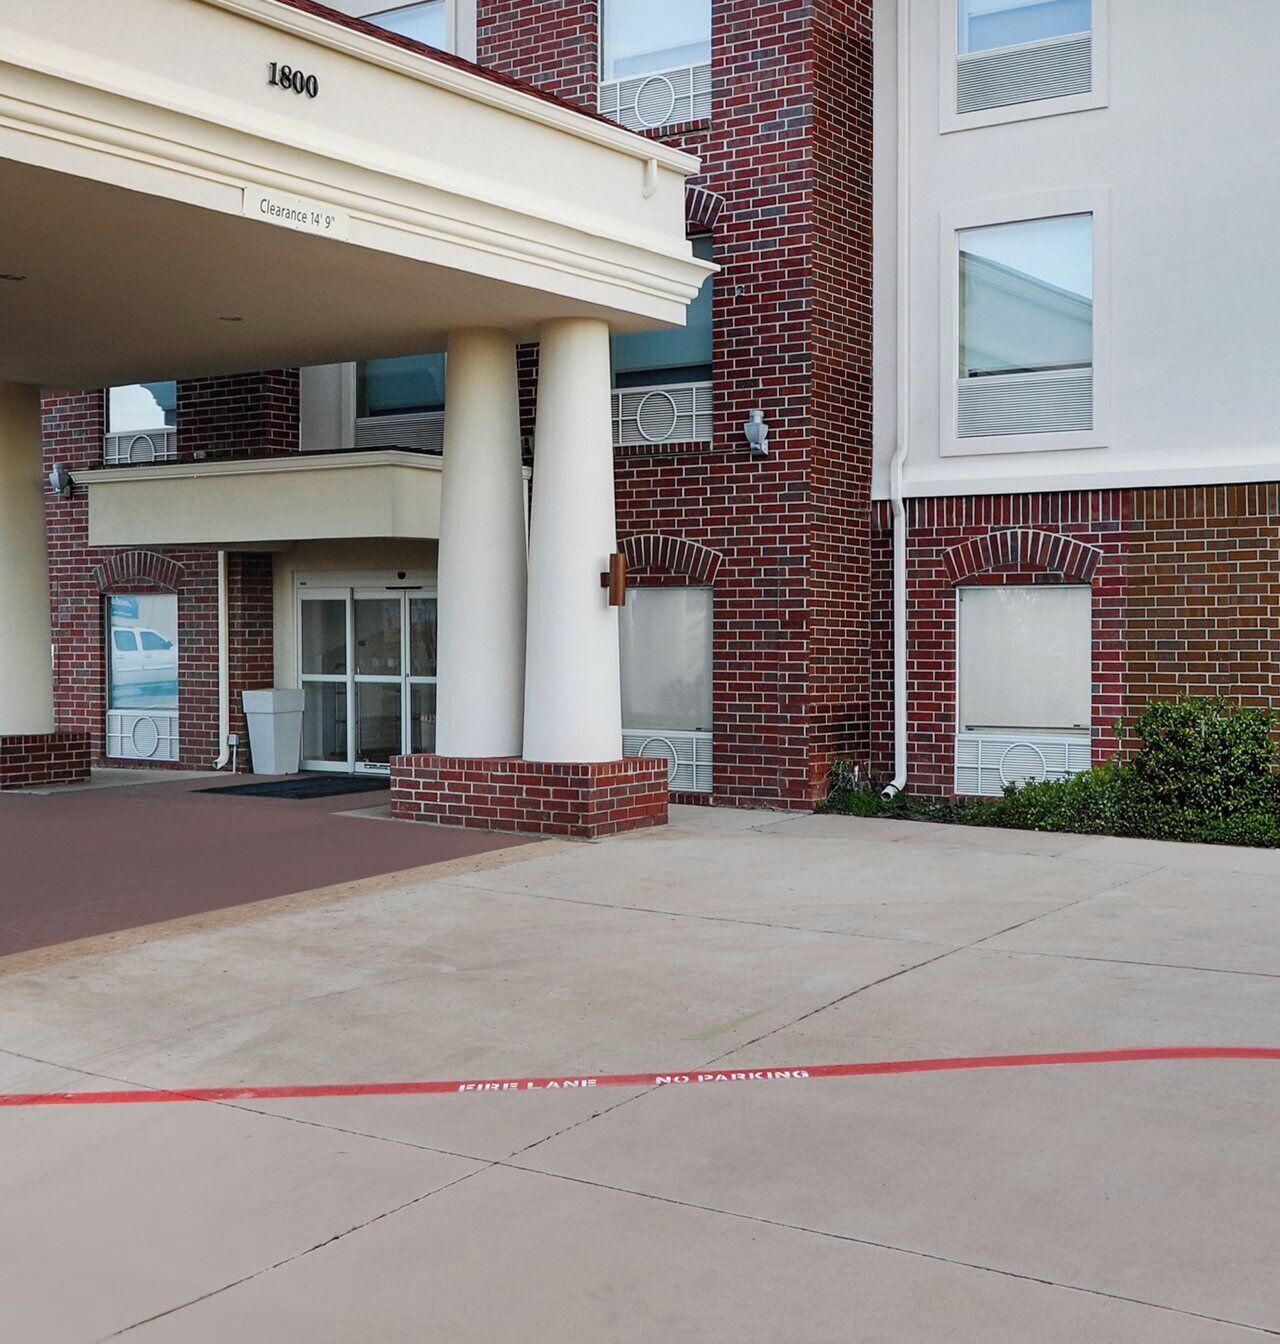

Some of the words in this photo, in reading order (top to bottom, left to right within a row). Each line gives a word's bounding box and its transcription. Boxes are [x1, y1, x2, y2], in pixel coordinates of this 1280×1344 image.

[267, 61, 319, 98] 1800
[259, 198, 308, 225] Clearance
[458, 1082, 519, 1093] FIRE
[526, 1079, 597, 1090] LANE
[655, 1075, 690, 1085] NO
[697, 1070, 809, 1083] PARKING
